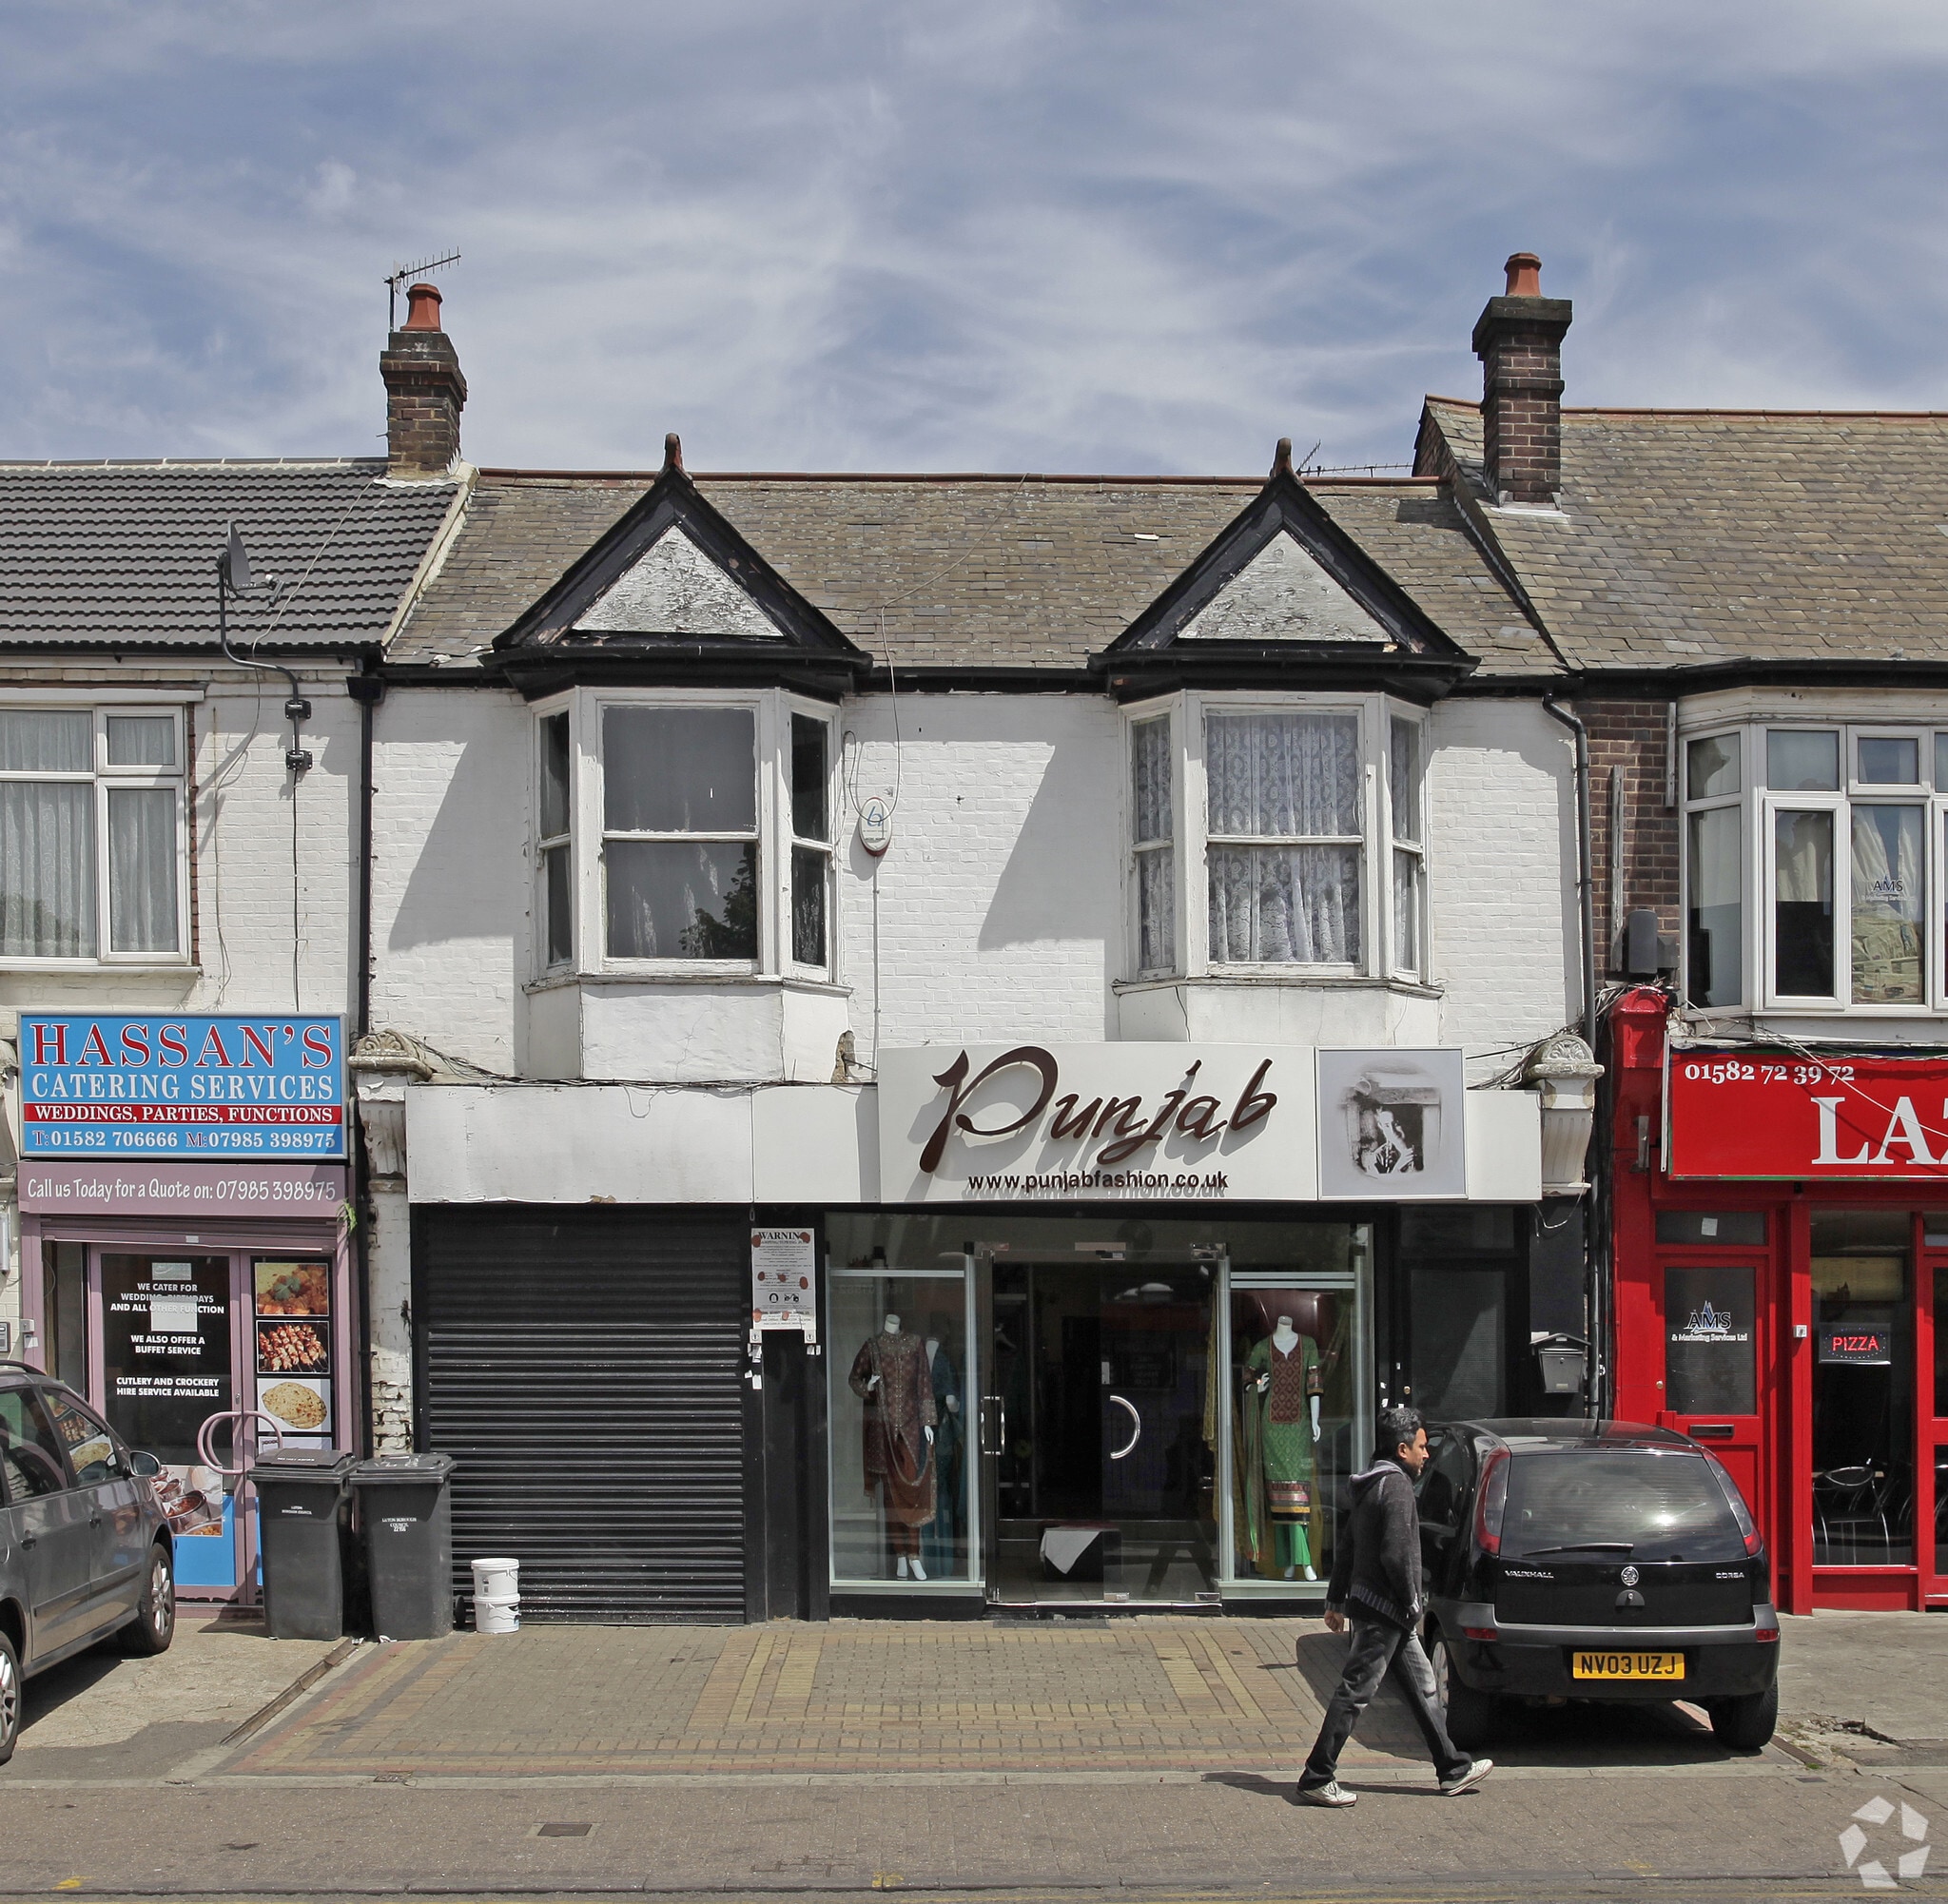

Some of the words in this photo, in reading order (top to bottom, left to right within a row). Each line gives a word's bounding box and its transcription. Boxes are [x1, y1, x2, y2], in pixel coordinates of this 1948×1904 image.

[1873, 880, 1903, 892] AMS
[30, 1023, 333, 1069] HASSAN'S
[1685, 1060, 1755, 1084] 01582
[1761, 1065, 1787, 1085] 72
[1793, 1065, 1821, 1085] 39
[1829, 1065, 1855, 1085] 72
[31, 1073, 180, 1099] CATERING
[190, 1075, 333, 1100] SERVICES
[35, 1105, 137, 1122] WEDDINGS,
[143, 1106, 224, 1123] PARTIES,
[227, 1107, 333, 1122] FUNCTIONS
[919, 1045, 1278, 1173] Punjab
[1810, 1096, 1948, 1165] LA
[112, 1131, 178, 1147] 706666
[270, 1132, 336, 1148] 398975
[968, 1170, 1229, 1193] www.punjabfashion.co.uk
[28, 1178, 52, 1198] Call
[55, 1184, 71, 1198] us
[73, 1178, 113, 1203] Today
[115, 1178, 135, 1199] for
[138, 1185, 146, 1198] a
[148, 1178, 190, 1200] Quote
[194, 1184, 213, 1199] on:
[216, 1179, 269, 1201] 07985
[272, 1180, 336, 1202] 398975
[758, 1232, 801, 1240] WARNIN
[137, 1283, 150, 1292] WE
[152, 1283, 178, 1292] CATER
[180, 1284, 198, 1292] FOR
[149, 1304, 178, 1313] OTHER
[180, 1305, 224, 1313] FUNCTION
[1687, 1311, 1732, 1330] AMS
[146, 1335, 168, 1344] ALSO
[170, 1335, 197, 1344] OFFER
[198, 1336, 205, 1345] A
[1832, 1335, 1880, 1351] PIZZA
[135, 1346, 166, 1354] BUFFET
[116, 1377, 152, 1386] CUTLERY
[153, 1377, 173, 1386] AND
[175, 1378, 219, 1387] CROCKERY
[138, 1388, 172, 1396] SERVICE
[173, 1389, 219, 1397] AVAILABLE
[1505, 1569, 1554, 1579] VAUXHALL
[1580, 1655, 1632, 1675] NV03
[1637, 1655, 1677, 1675] UZJ
